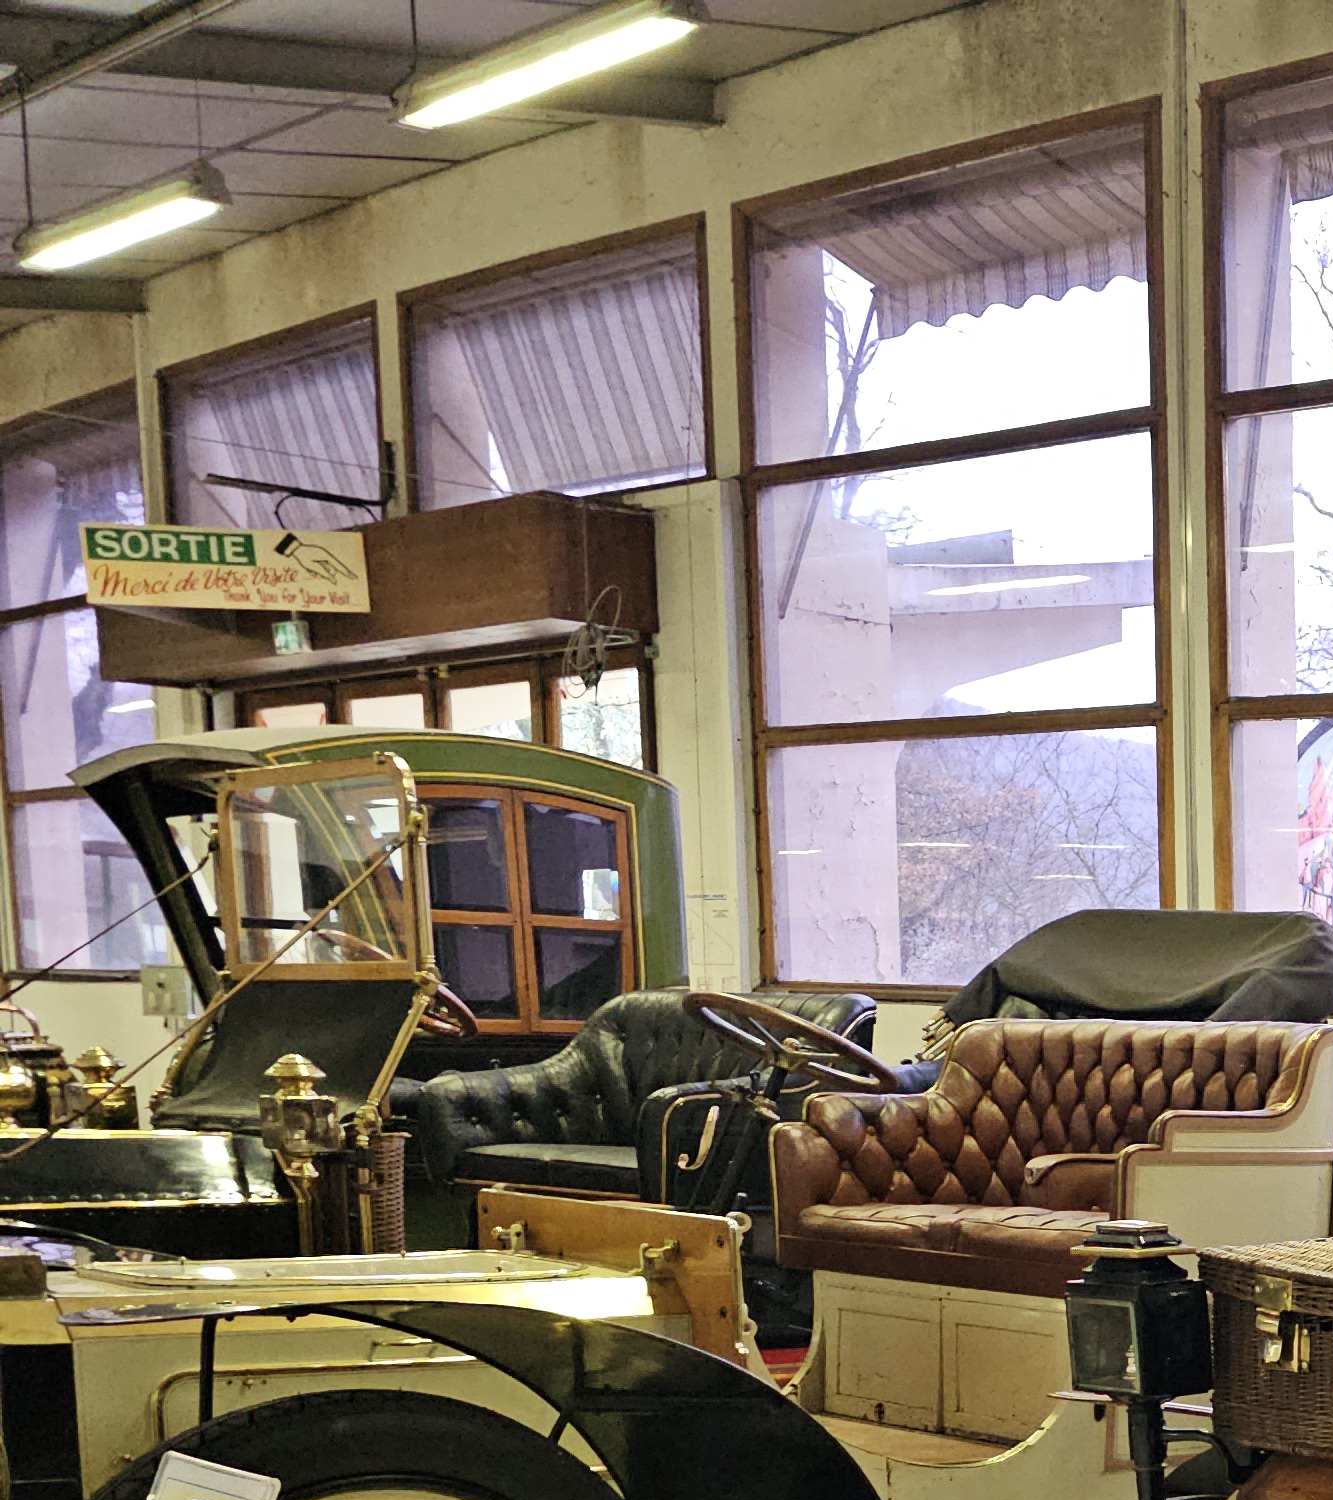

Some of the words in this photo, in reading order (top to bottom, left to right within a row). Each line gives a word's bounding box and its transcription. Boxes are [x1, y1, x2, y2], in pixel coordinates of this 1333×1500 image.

[95, 531, 249, 563] SORTIE
[92, 563, 172, 598] Merci
[173, 570, 199, 592] de
[203, 568, 248, 590] Votre
[251, 566, 299, 587] Visite
